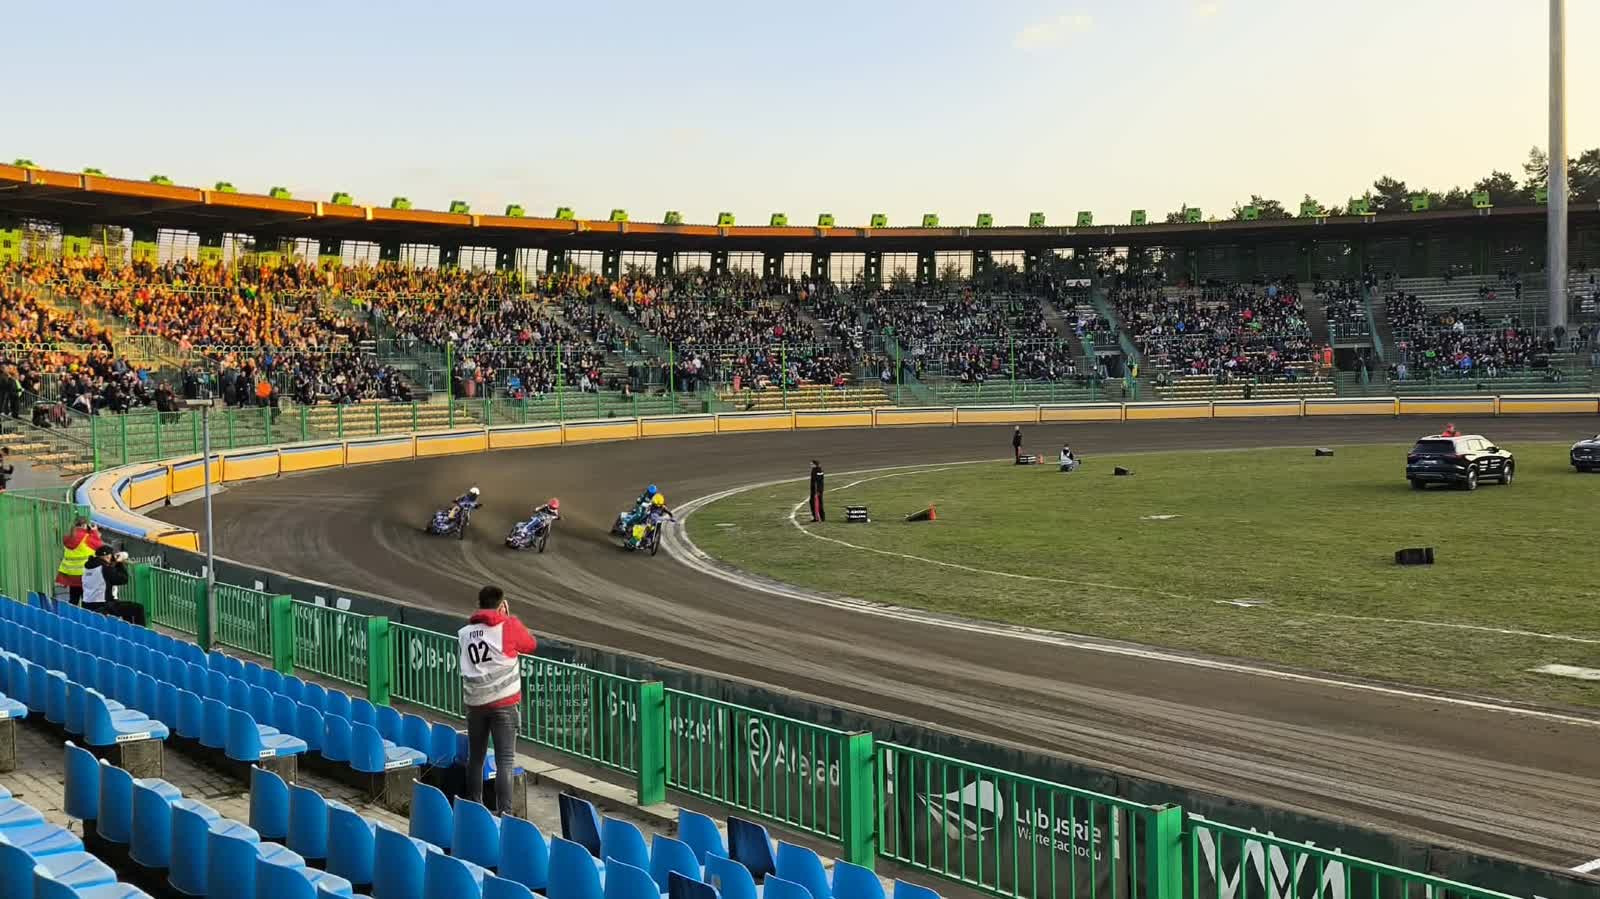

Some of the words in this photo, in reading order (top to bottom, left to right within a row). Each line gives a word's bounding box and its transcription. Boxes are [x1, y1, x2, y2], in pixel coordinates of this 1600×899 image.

[469, 629, 484, 639] FOTO
[468, 640, 492, 664] 02
[1016, 801, 1101, 844] Lubuskie
